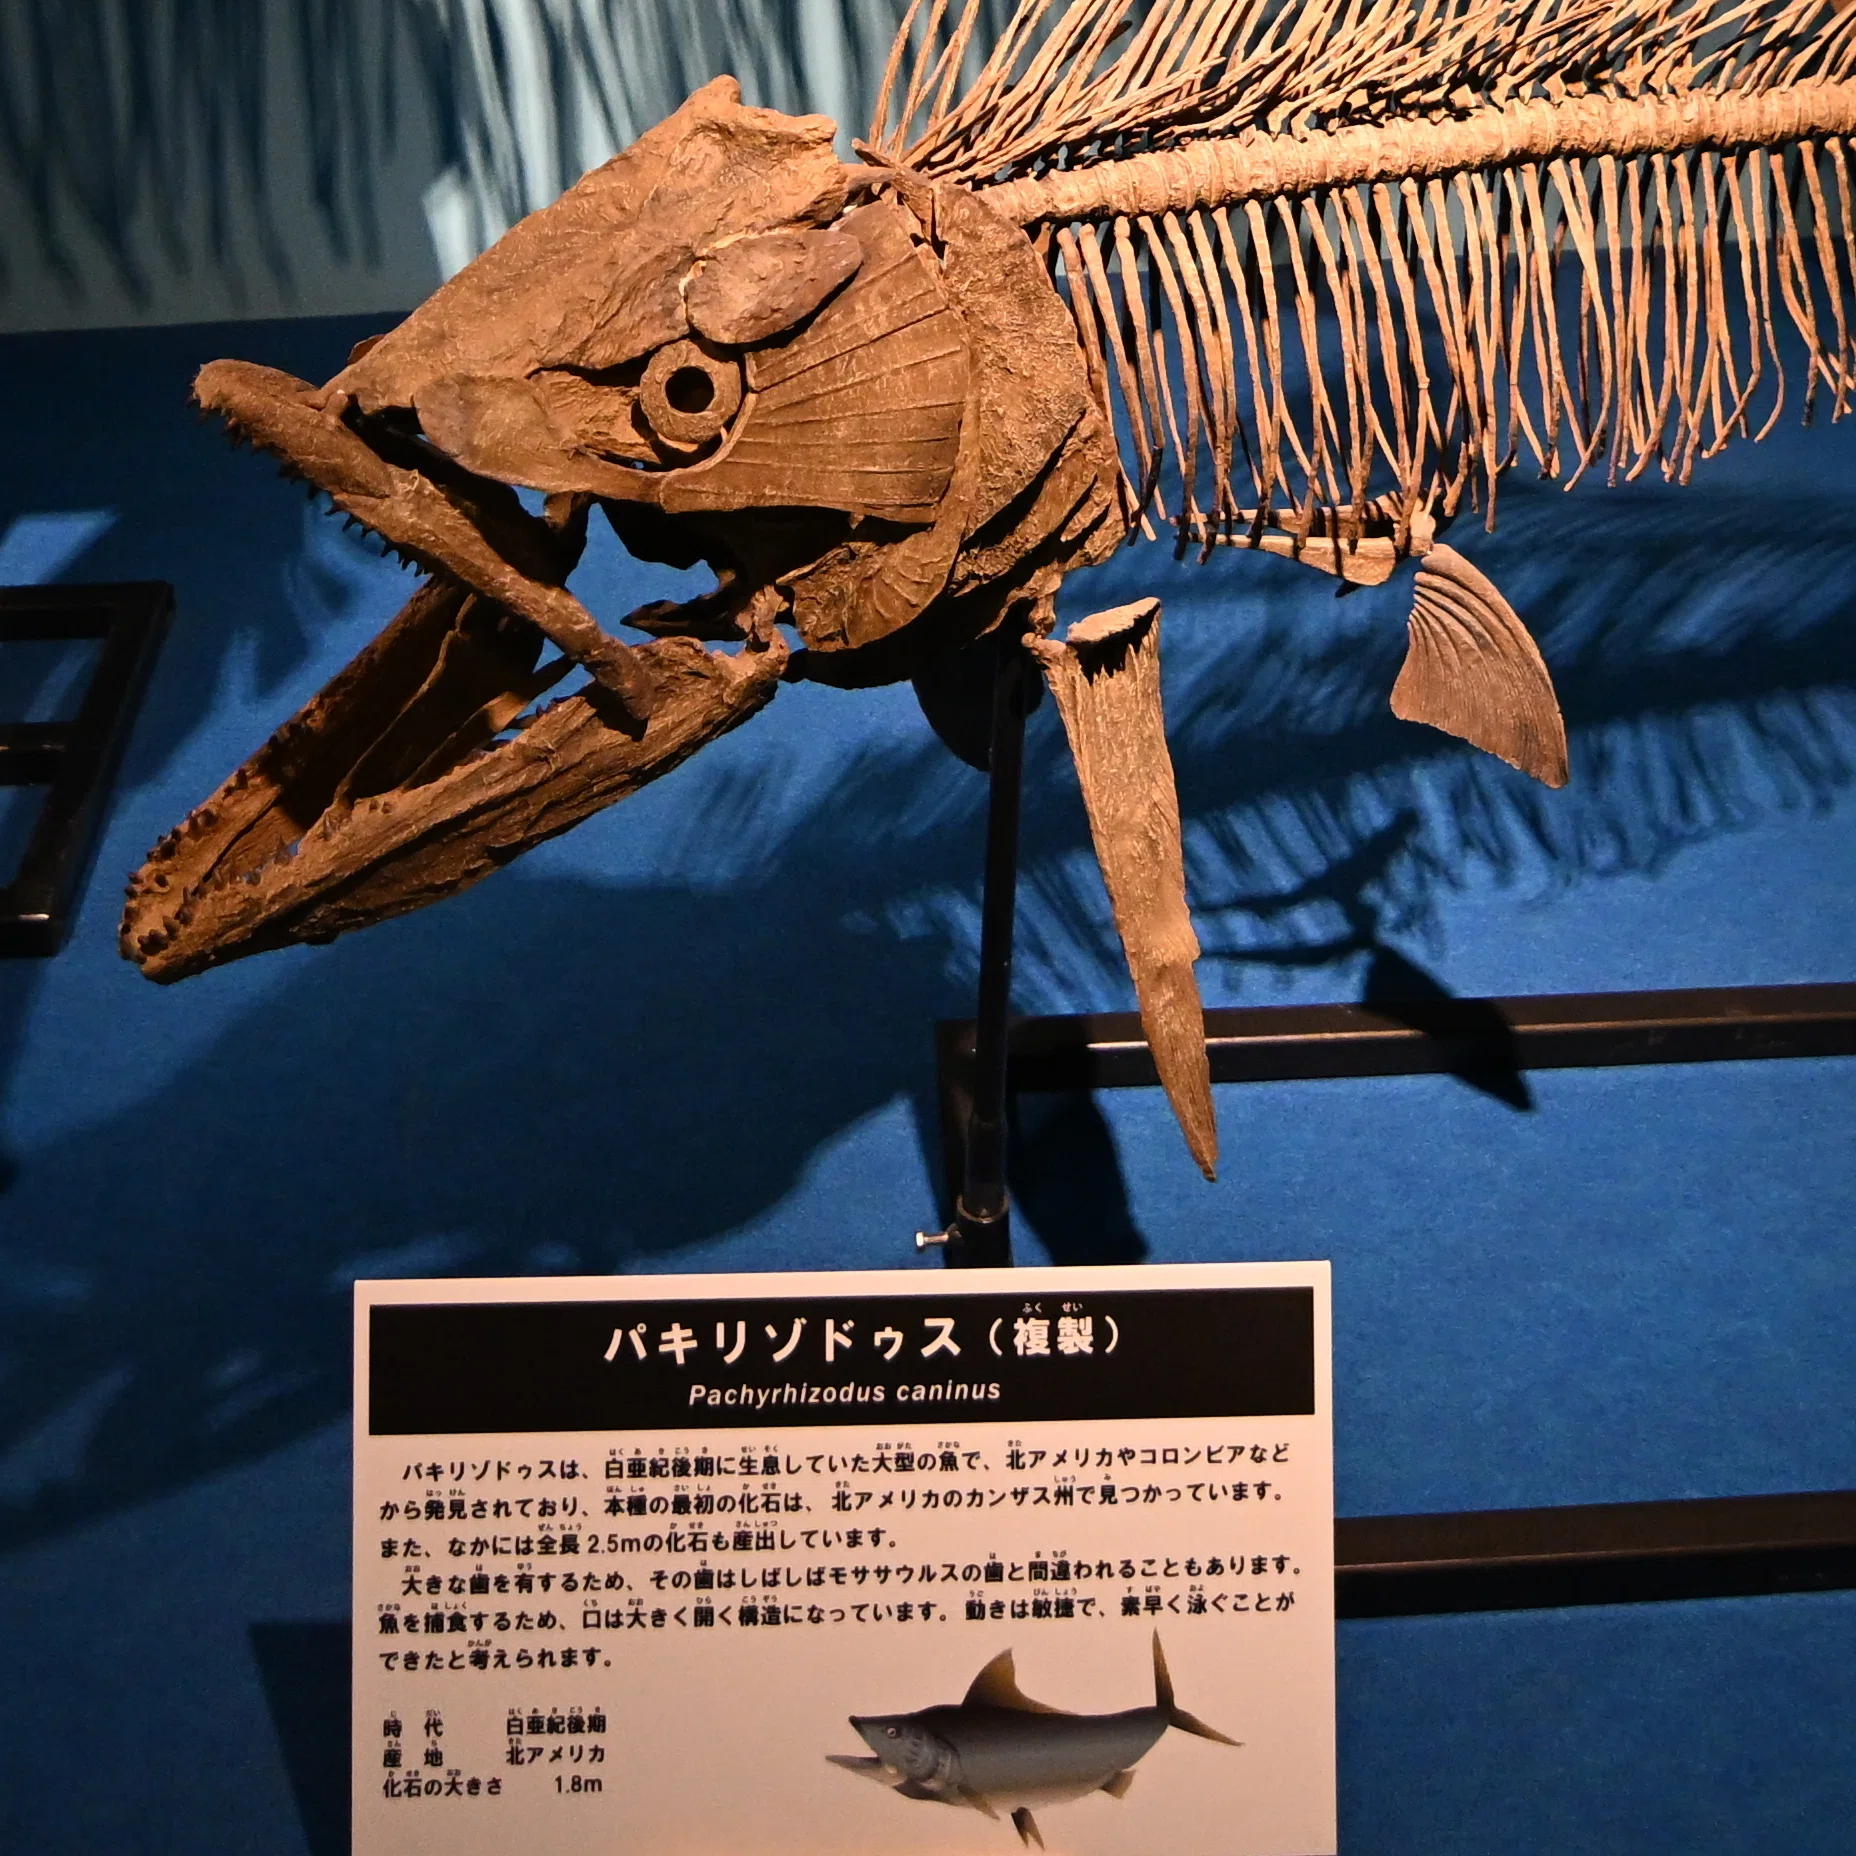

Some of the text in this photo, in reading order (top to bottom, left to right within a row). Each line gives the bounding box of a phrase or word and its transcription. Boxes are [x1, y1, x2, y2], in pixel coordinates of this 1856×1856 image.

[604, 1315, 1118, 1365] パキリゾドゥス（複製）
[689, 1380, 1001, 1409] Pachyrhizodus caninus
[379, 1647, 611, 1671] できたと考えられます。
[507, 1713, 606, 1736] 白亜紀後期
[506, 1744, 604, 1766] 北アメリカ
[383, 1775, 602, 1798] 化石の大きさ 1.8m
